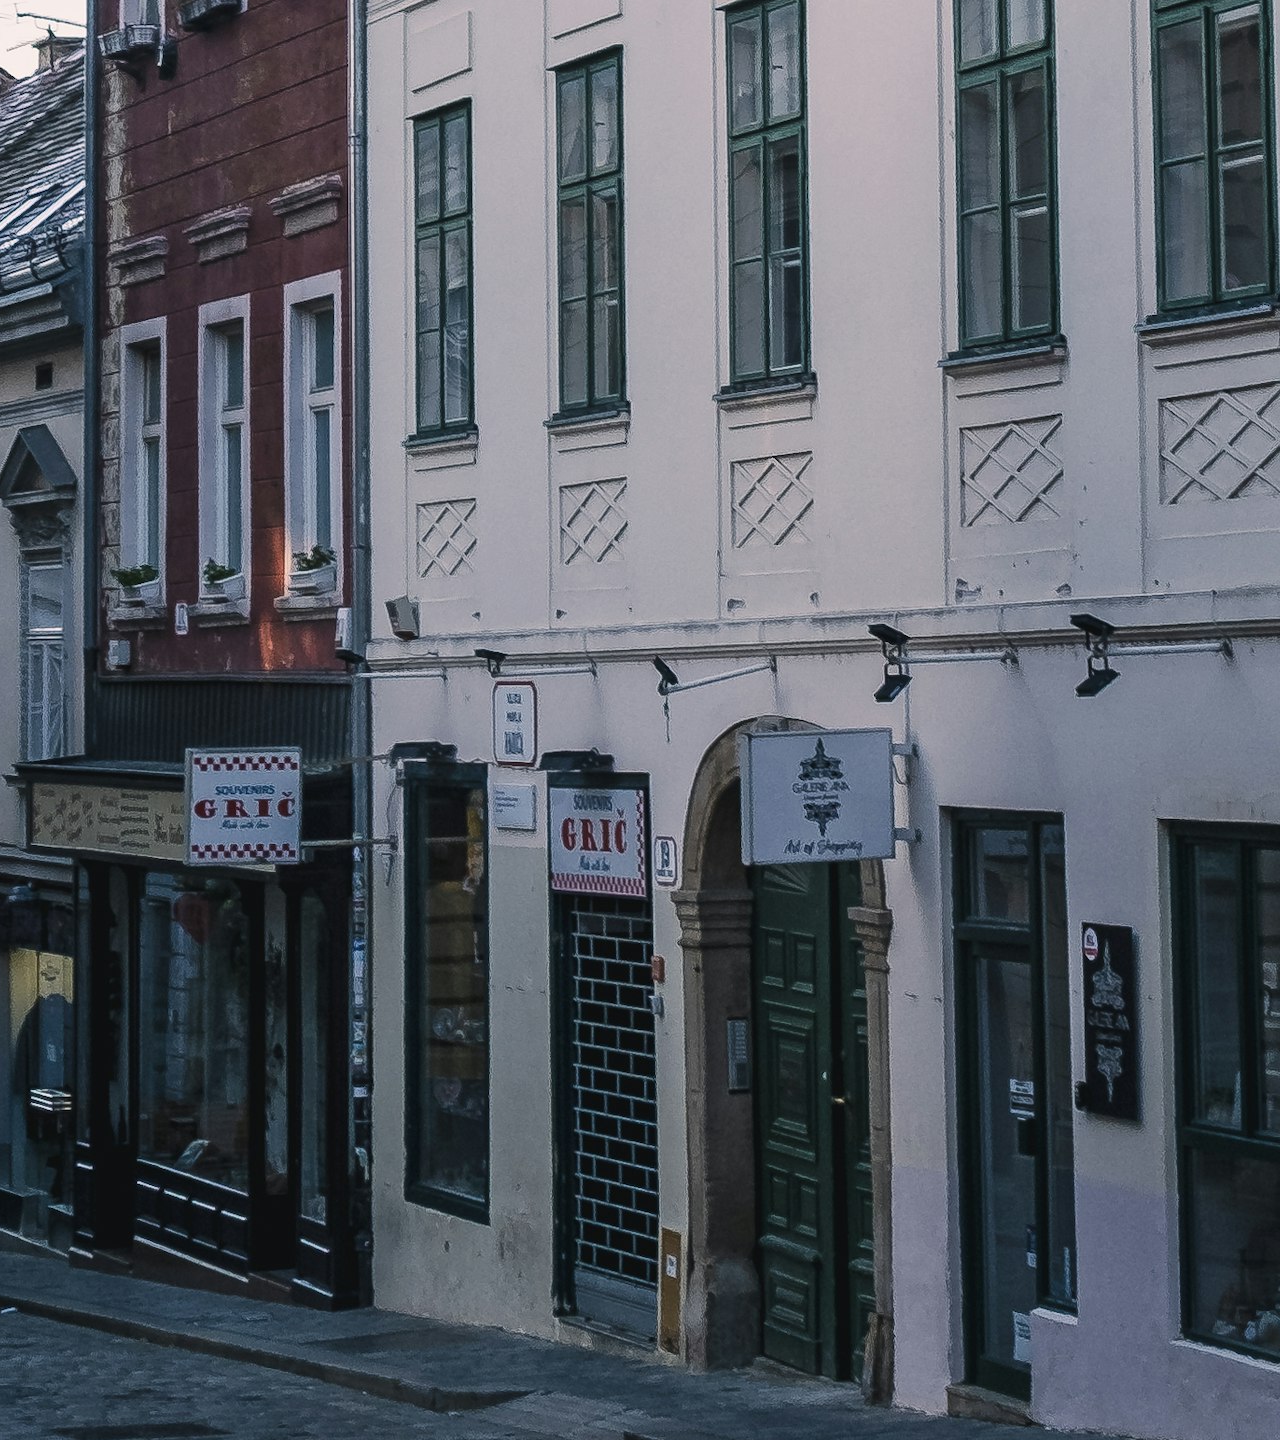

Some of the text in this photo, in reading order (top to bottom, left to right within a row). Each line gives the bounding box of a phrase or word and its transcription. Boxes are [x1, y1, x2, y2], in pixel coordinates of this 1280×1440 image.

[215, 785, 275, 796] SOUVENIRS
[194, 792, 296, 818] GRIČ
[573, 794, 613, 812] SOUVENIRS
[561, 808, 628, 854] GRIČ
